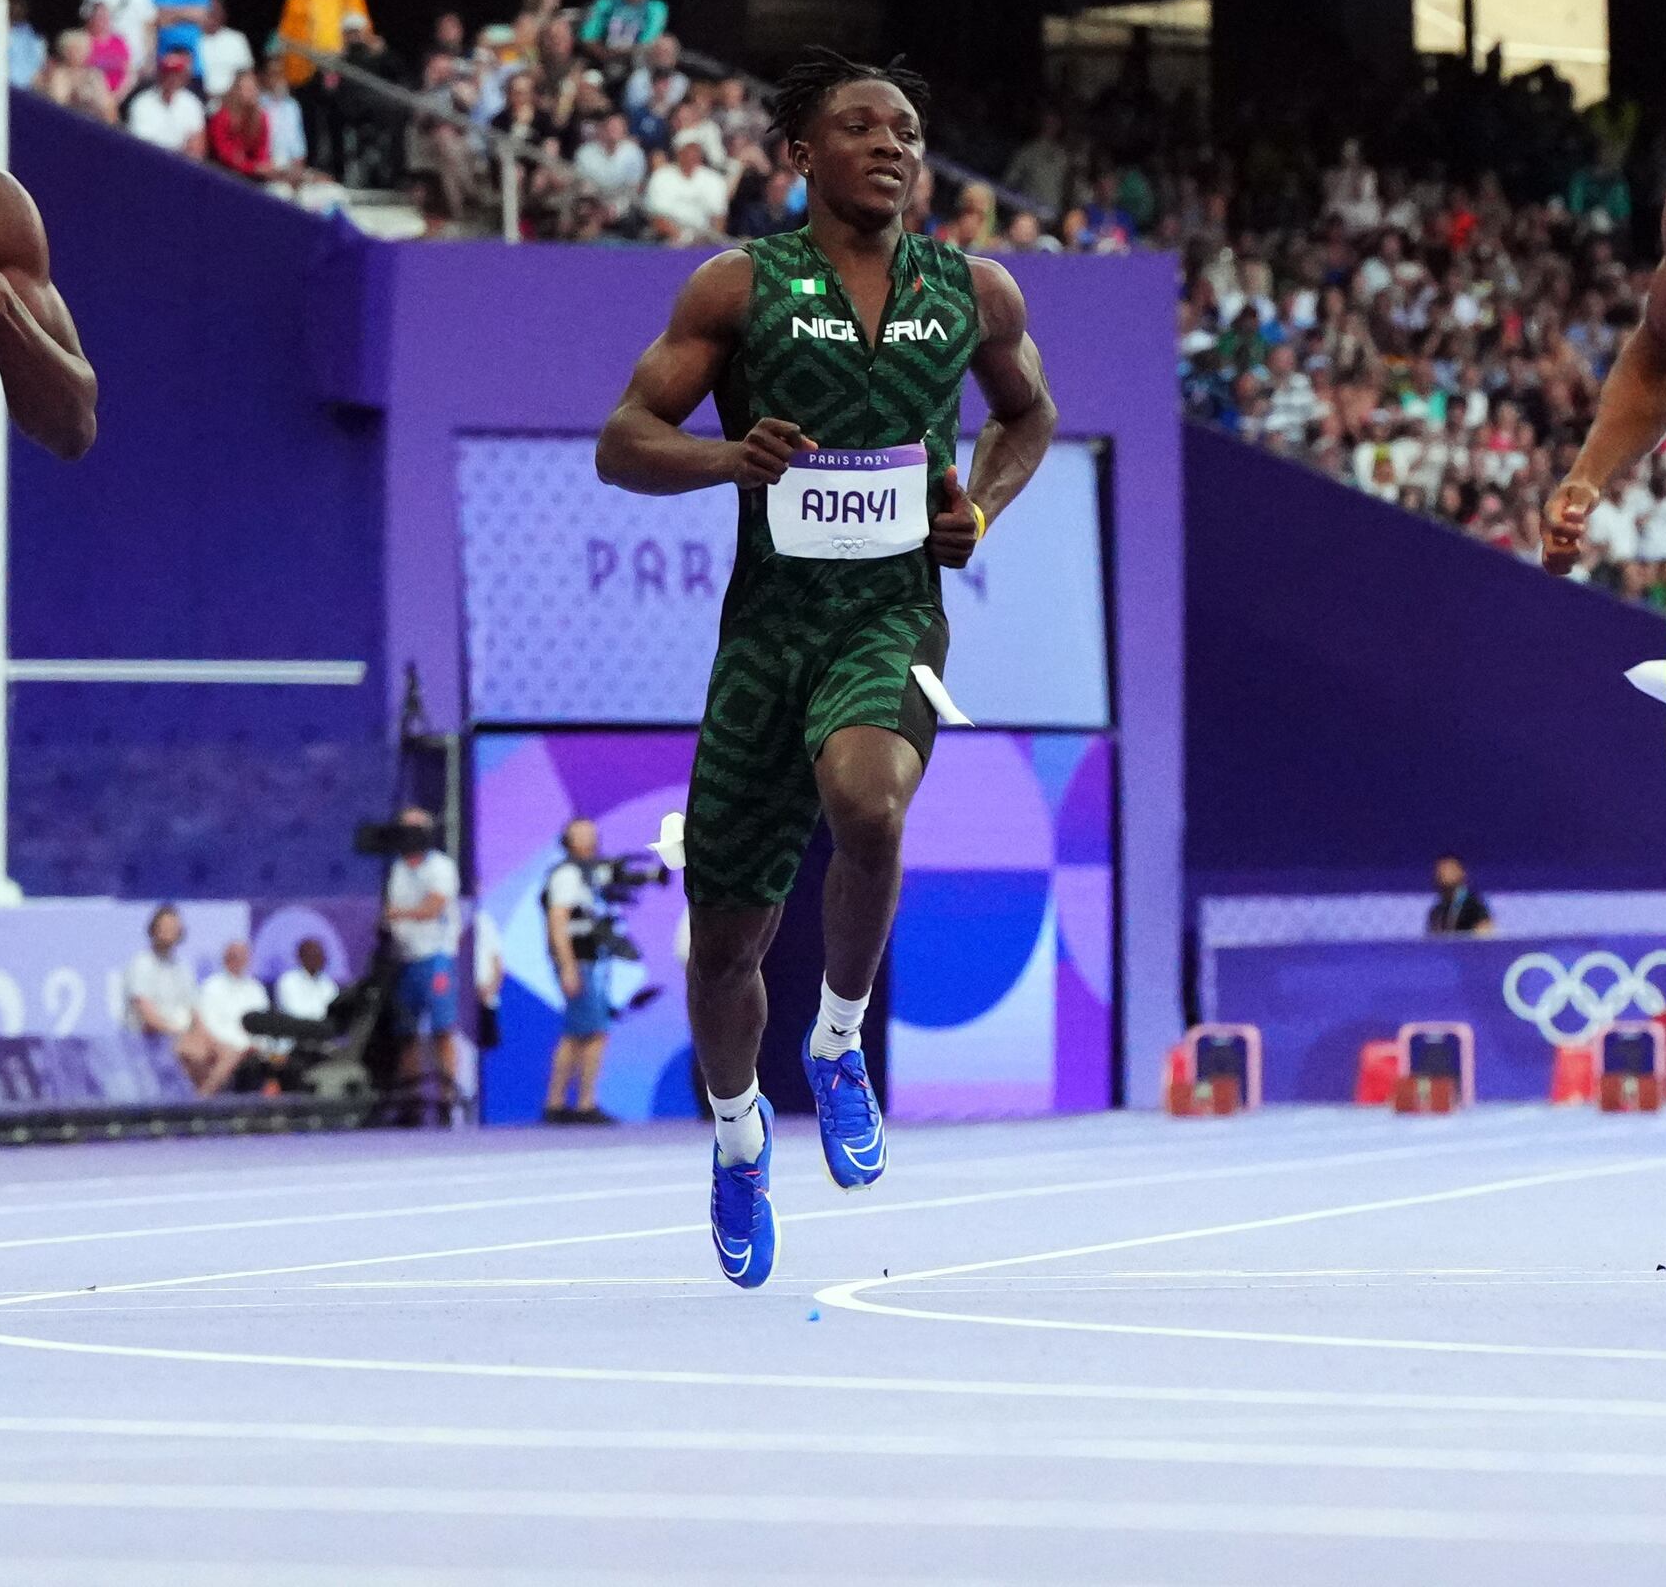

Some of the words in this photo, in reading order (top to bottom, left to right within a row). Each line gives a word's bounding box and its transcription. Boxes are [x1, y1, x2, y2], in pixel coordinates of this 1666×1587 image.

[792, 316, 948, 343] NIGERIA
[809, 454, 850, 465] PARIS
[854, 455, 890, 466] 2024
[801, 488, 896, 523] AJAYI
